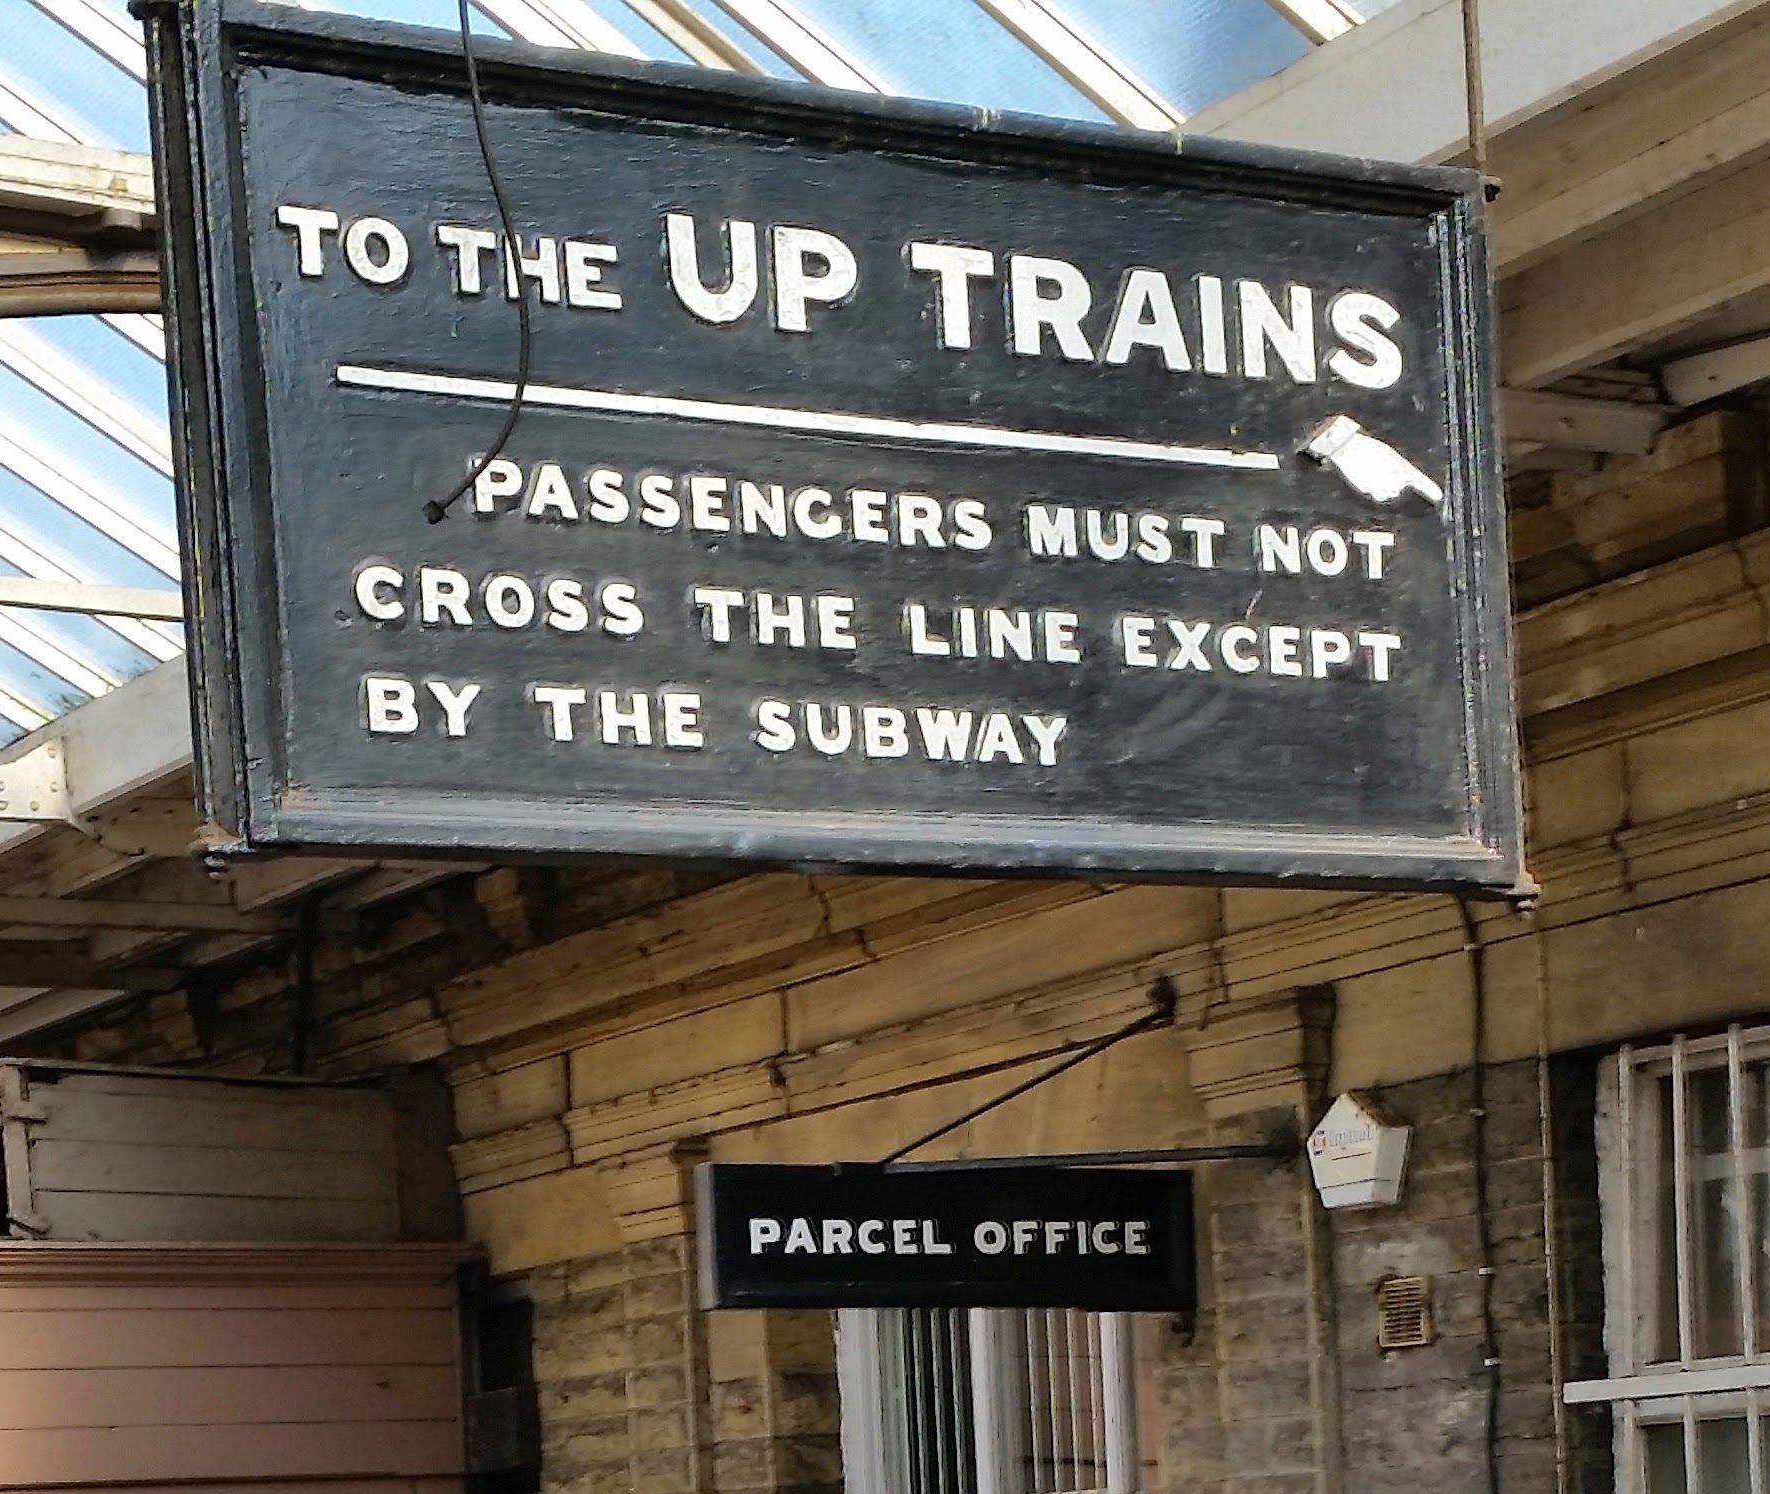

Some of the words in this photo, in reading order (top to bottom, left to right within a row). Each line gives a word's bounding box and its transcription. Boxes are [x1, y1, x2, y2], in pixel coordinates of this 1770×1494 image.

[277, 205, 409, 285] TO
[437, 224, 623, 310] THE
[665, 212, 859, 333] UP
[910, 240, 1404, 390] TRAINS
[469, 458, 994, 551] PASSENGERS
[1027, 505, 1226, 570] MUST
[1257, 524, 1396, 580] NOT
[355, 565, 645, 636] CROSS
[694, 587, 858, 651] THE
[906, 602, 1082, 664] LINE
[1121, 615, 1402, 682] EXCEPT
[365, 677, 479, 737] BY
[534, 686, 704, 748] THE
[751, 699, 1068, 767] SUBWAY
[748, 1217, 955, 1256] PARCEL
[973, 1220, 1151, 1256] OFFICE
